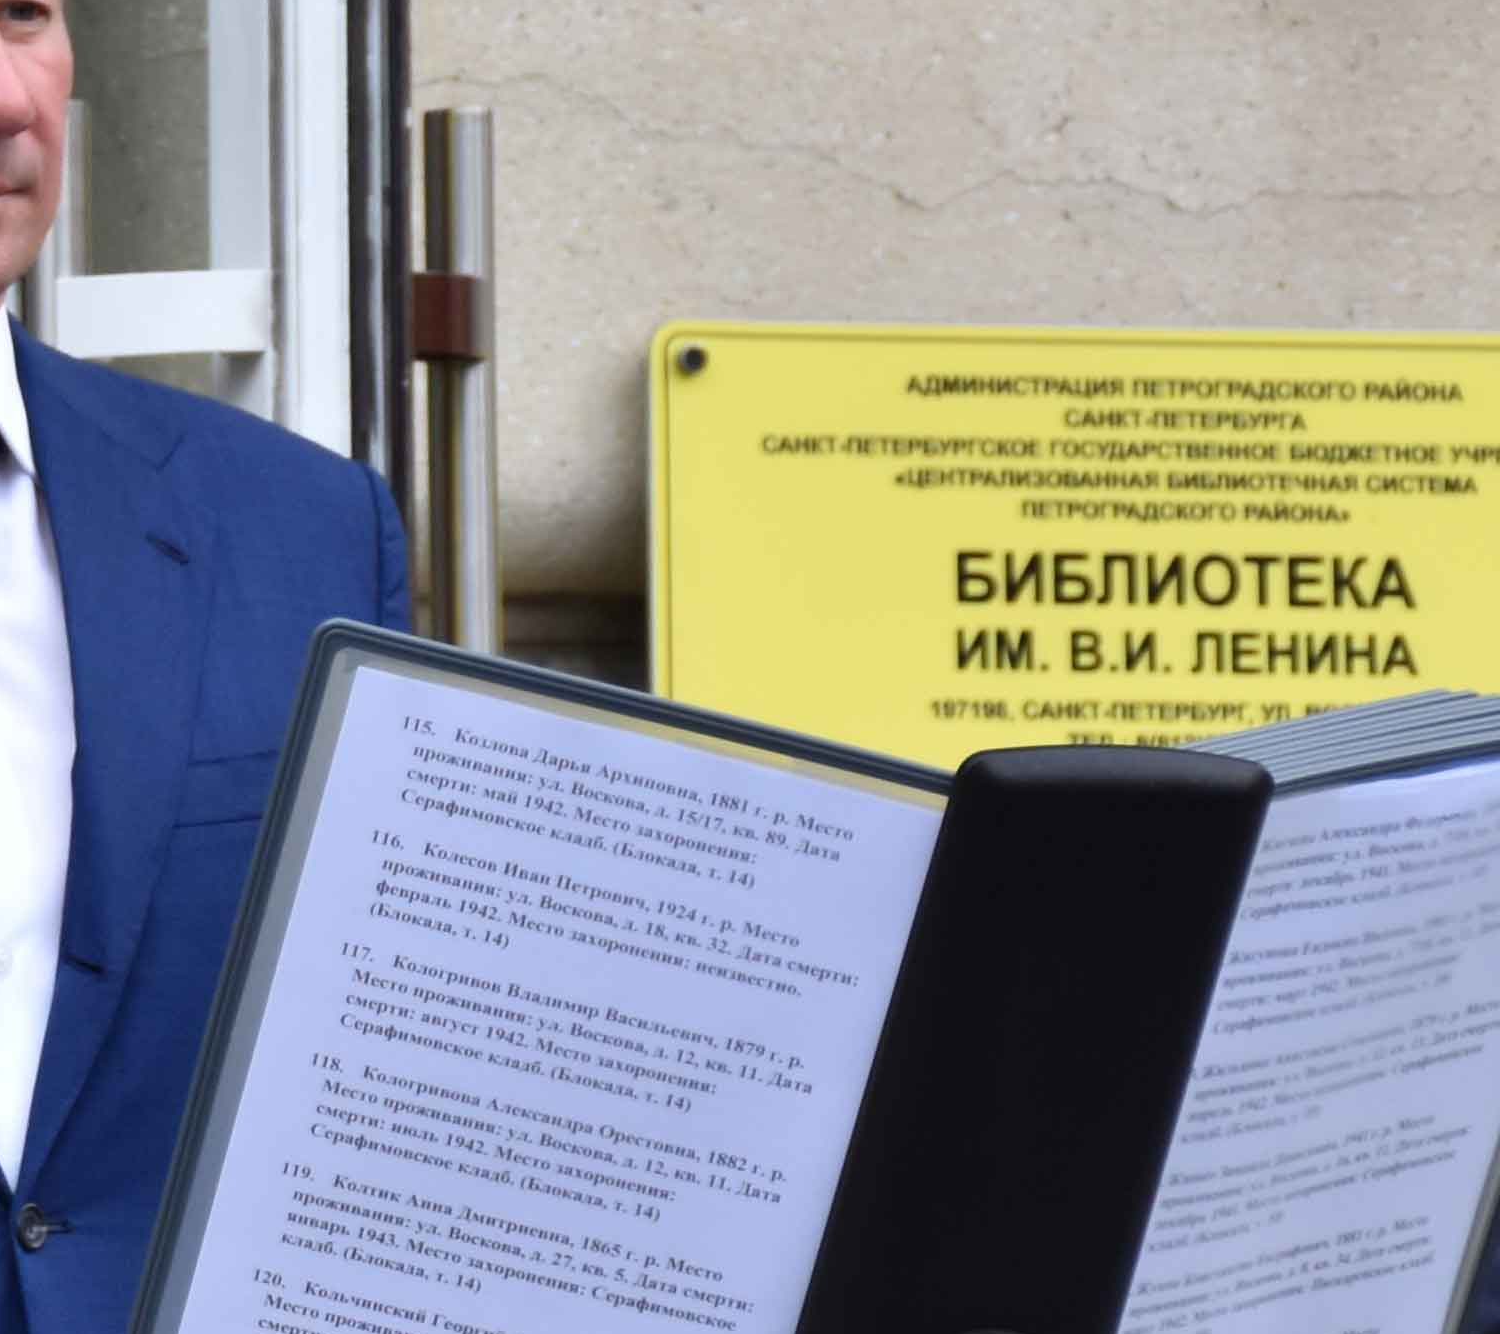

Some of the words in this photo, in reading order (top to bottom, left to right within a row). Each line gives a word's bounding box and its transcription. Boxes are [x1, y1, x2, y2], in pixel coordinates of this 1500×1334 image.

[904, 373, 1125, 400] АДМИНИСТРАЦИЯ
[1132, 377, 1357, 403] ПЕТРОГРАДСКОГО
[1361, 378, 1464, 404] РАЙОНА
[1064, 410, 1305, 431] САНКТ-ПЕТЕРБУРГА
[760, 433, 1041, 459] САНКТ-ПЕТЕРБУРГСКОЕ
[1049, 438, 1280, 464] ГОСУДАРСТВЕННОЕ
[1289, 442, 1442, 466] БЮДЖЕТНОЕ
[894, 467, 1158, 491] «ЦЕНТРАЛИЗОВАННАЯ
[1166, 471, 1359, 495] БИБЛИОТЕЧНАЯ
[1366, 474, 1478, 496] СИСТЕМА
[1020, 499, 1237, 524] ПЕТРОГРАДСКОГО
[1243, 502, 1351, 524] РАЙОНА»
[955, 549, 1417, 610] БИБЛИОТЕКА
[956, 628, 1049, 672] ИМ.
[1069, 629, 1172, 673] В.И.
[1189, 631, 1418, 677] ЛЕНИНА
